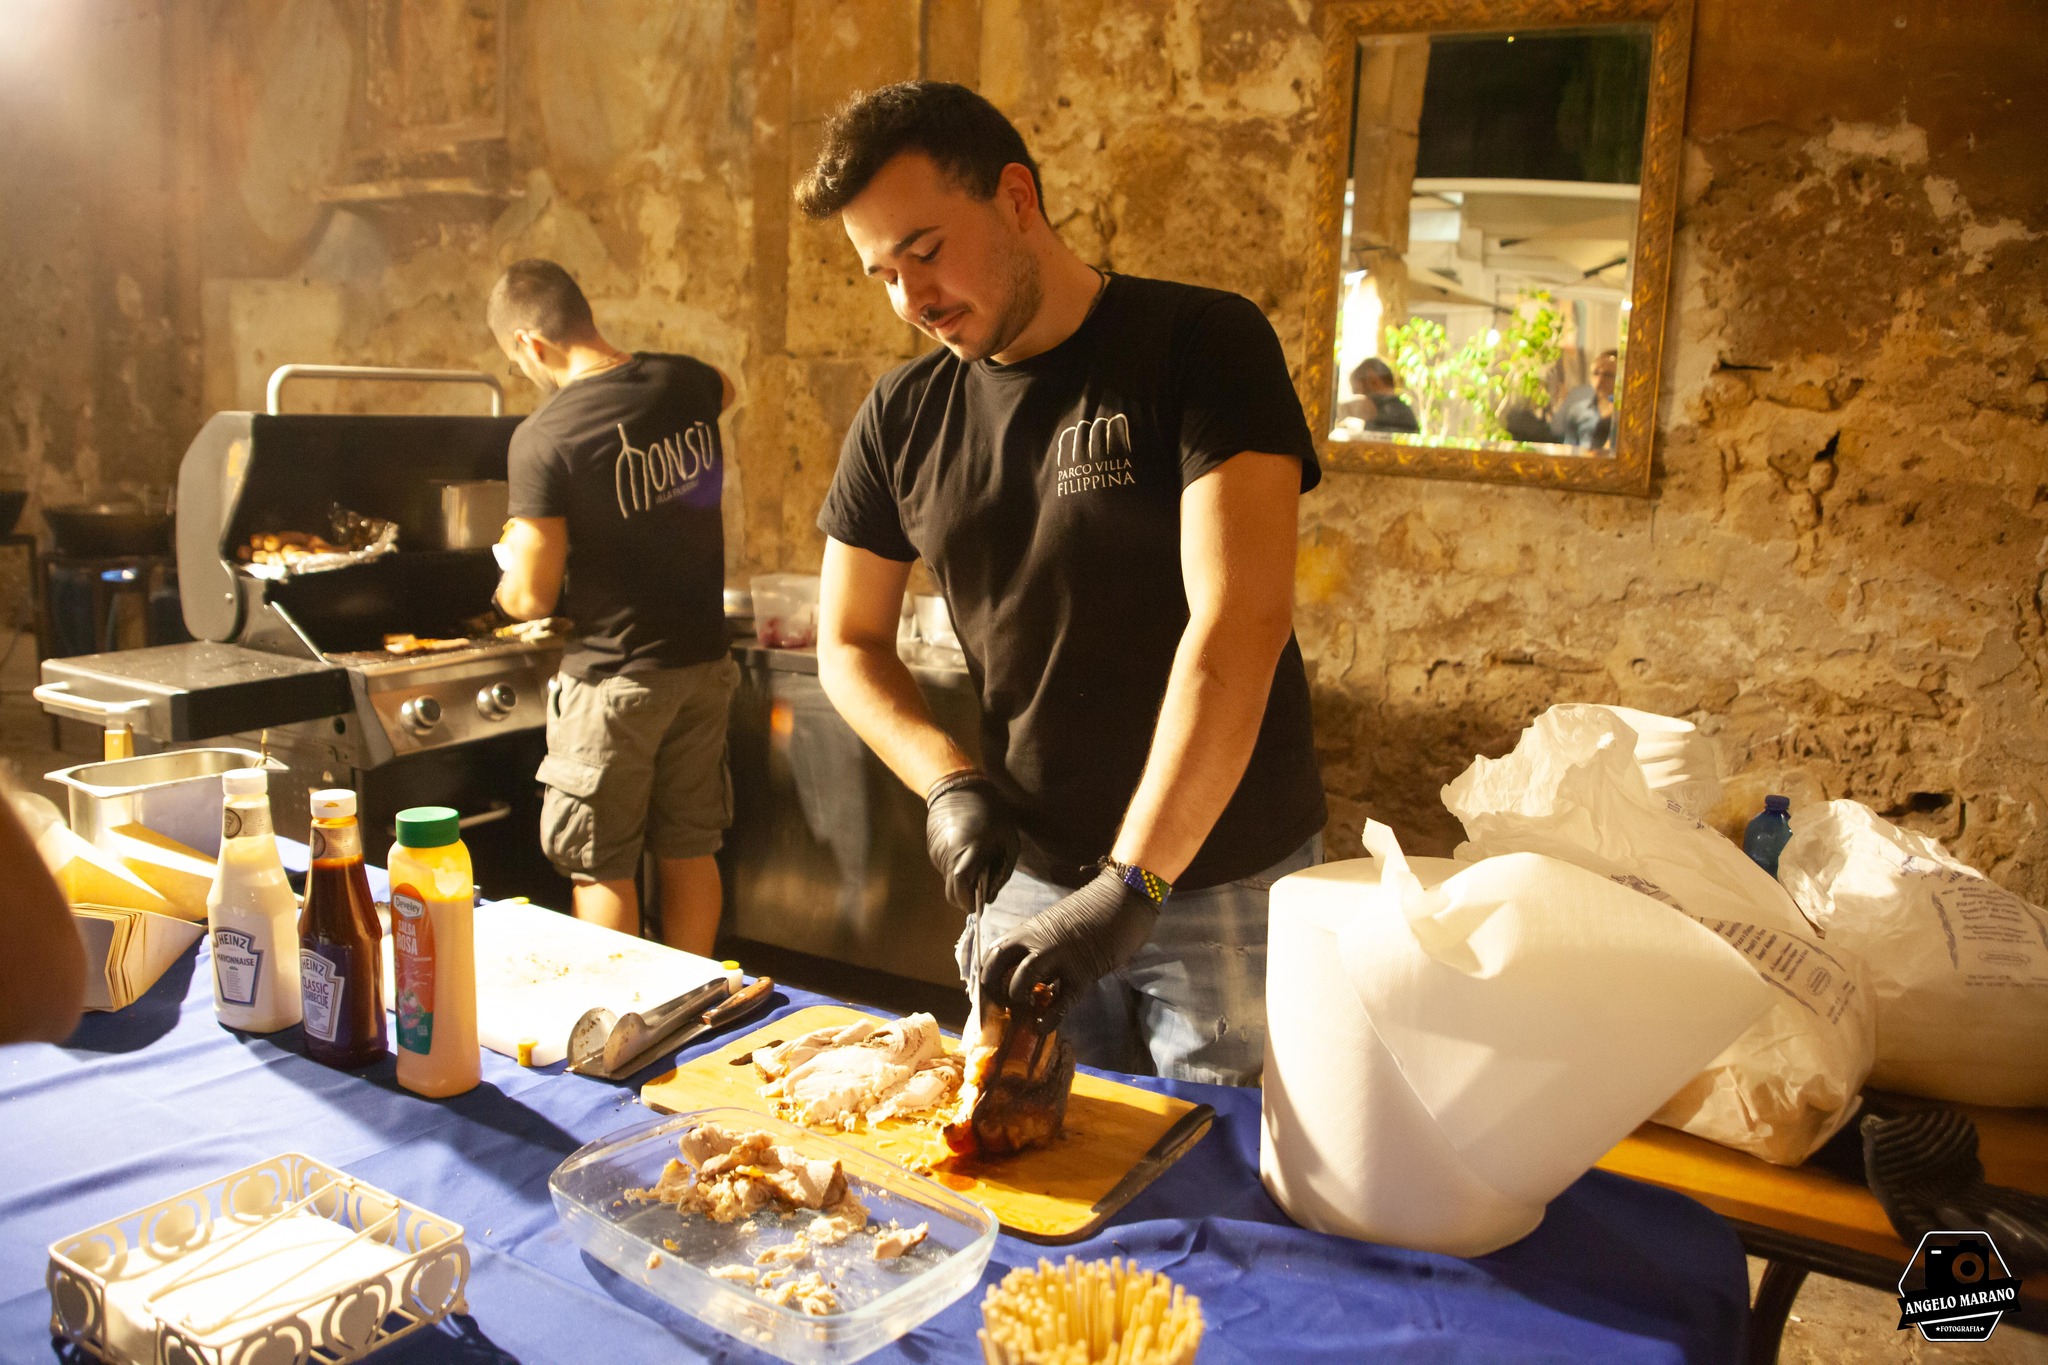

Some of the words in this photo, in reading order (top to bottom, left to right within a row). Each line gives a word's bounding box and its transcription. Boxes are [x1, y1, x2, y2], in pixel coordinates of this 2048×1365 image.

[1058, 463, 1092, 481] PARCO
[1095, 458, 1132, 472] VILLA
[1057, 471, 1136, 497] FILIPPINA
[395, 897, 421, 914] Develey
[217, 933, 247, 949] HEINZ
[217, 953, 255, 966] MAYONNAISE
[302, 958, 325, 976] HEINZ
[302, 976, 329, 995] CLASSIC
